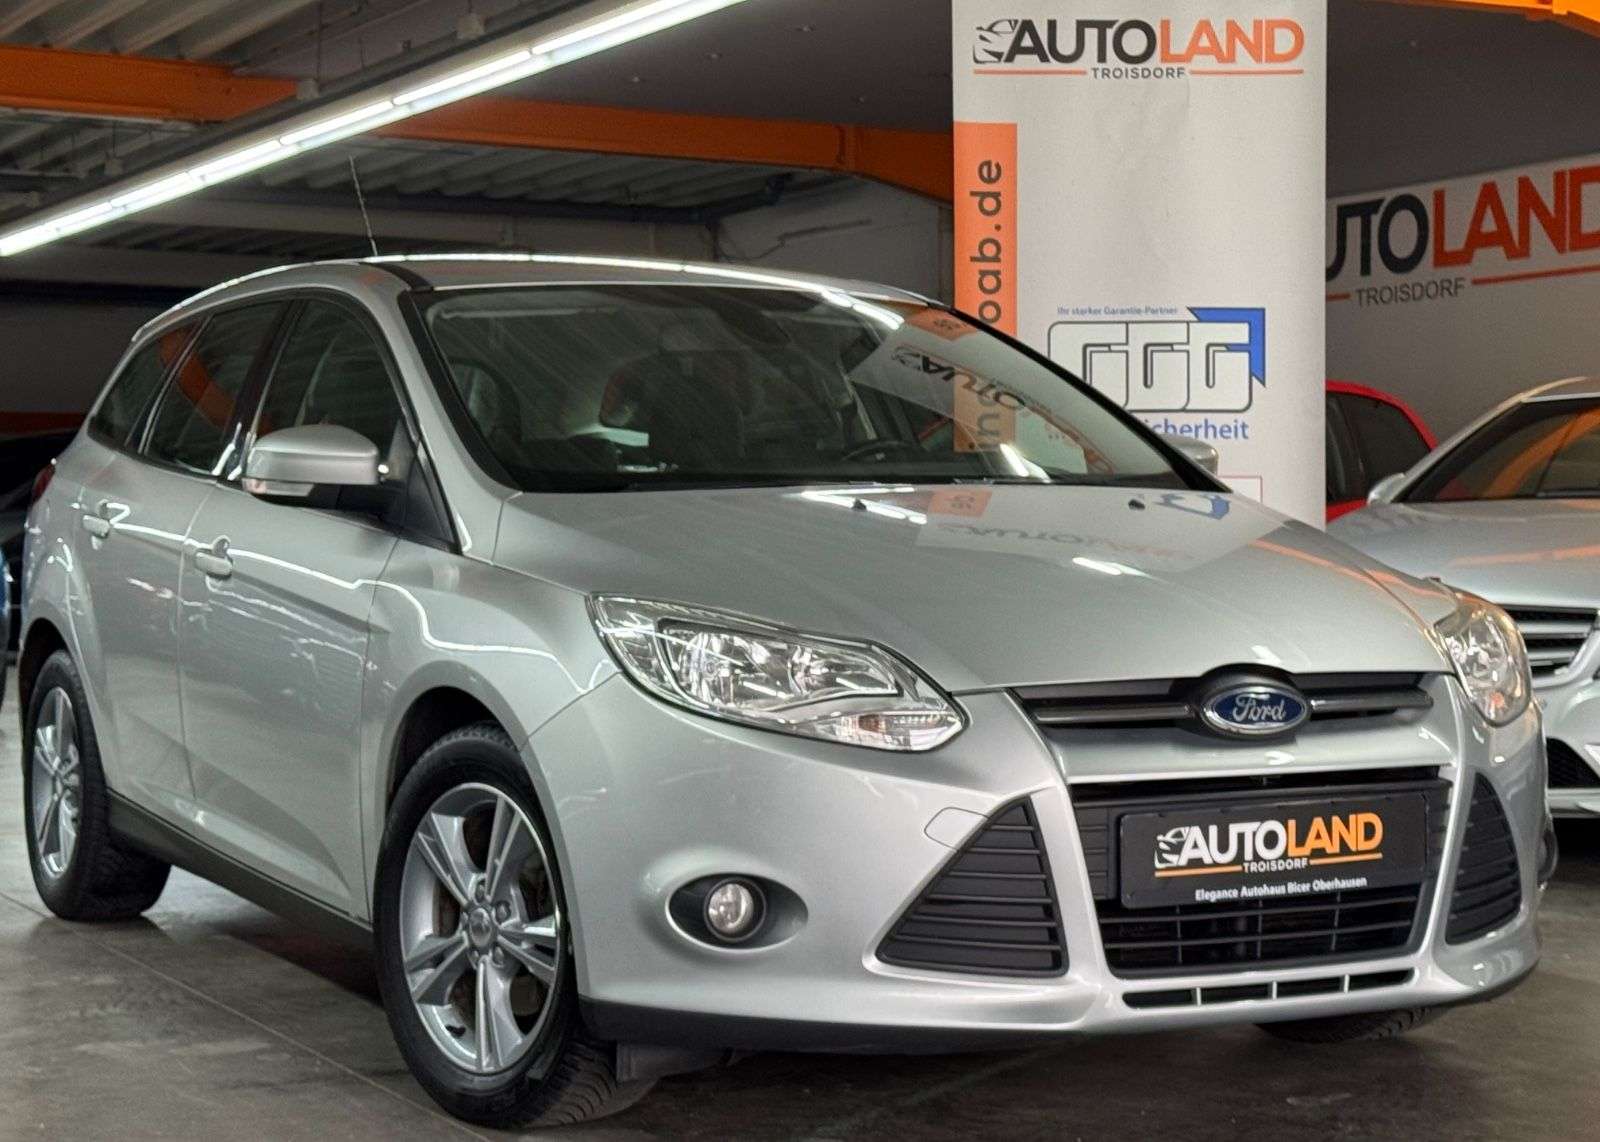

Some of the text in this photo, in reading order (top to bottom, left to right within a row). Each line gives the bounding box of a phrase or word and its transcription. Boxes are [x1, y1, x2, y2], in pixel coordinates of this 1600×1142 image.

[1003, 18, 1305, 64] AUTOLAND
[1091, 67, 1186, 80] TROISDORF
[1355, 277, 1467, 307] TROISDORF
[1057, 306, 1069, 316] Ihr
[1071, 306, 1102, 316] starker
[1231, 690, 1287, 722] Ford
[1176, 811, 1384, 866] AUTOLAND
[1242, 857, 1310, 874] TROISDORF
[1194, 876, 1368, 903] Elegance Autohaus Bicer Oberhausen
